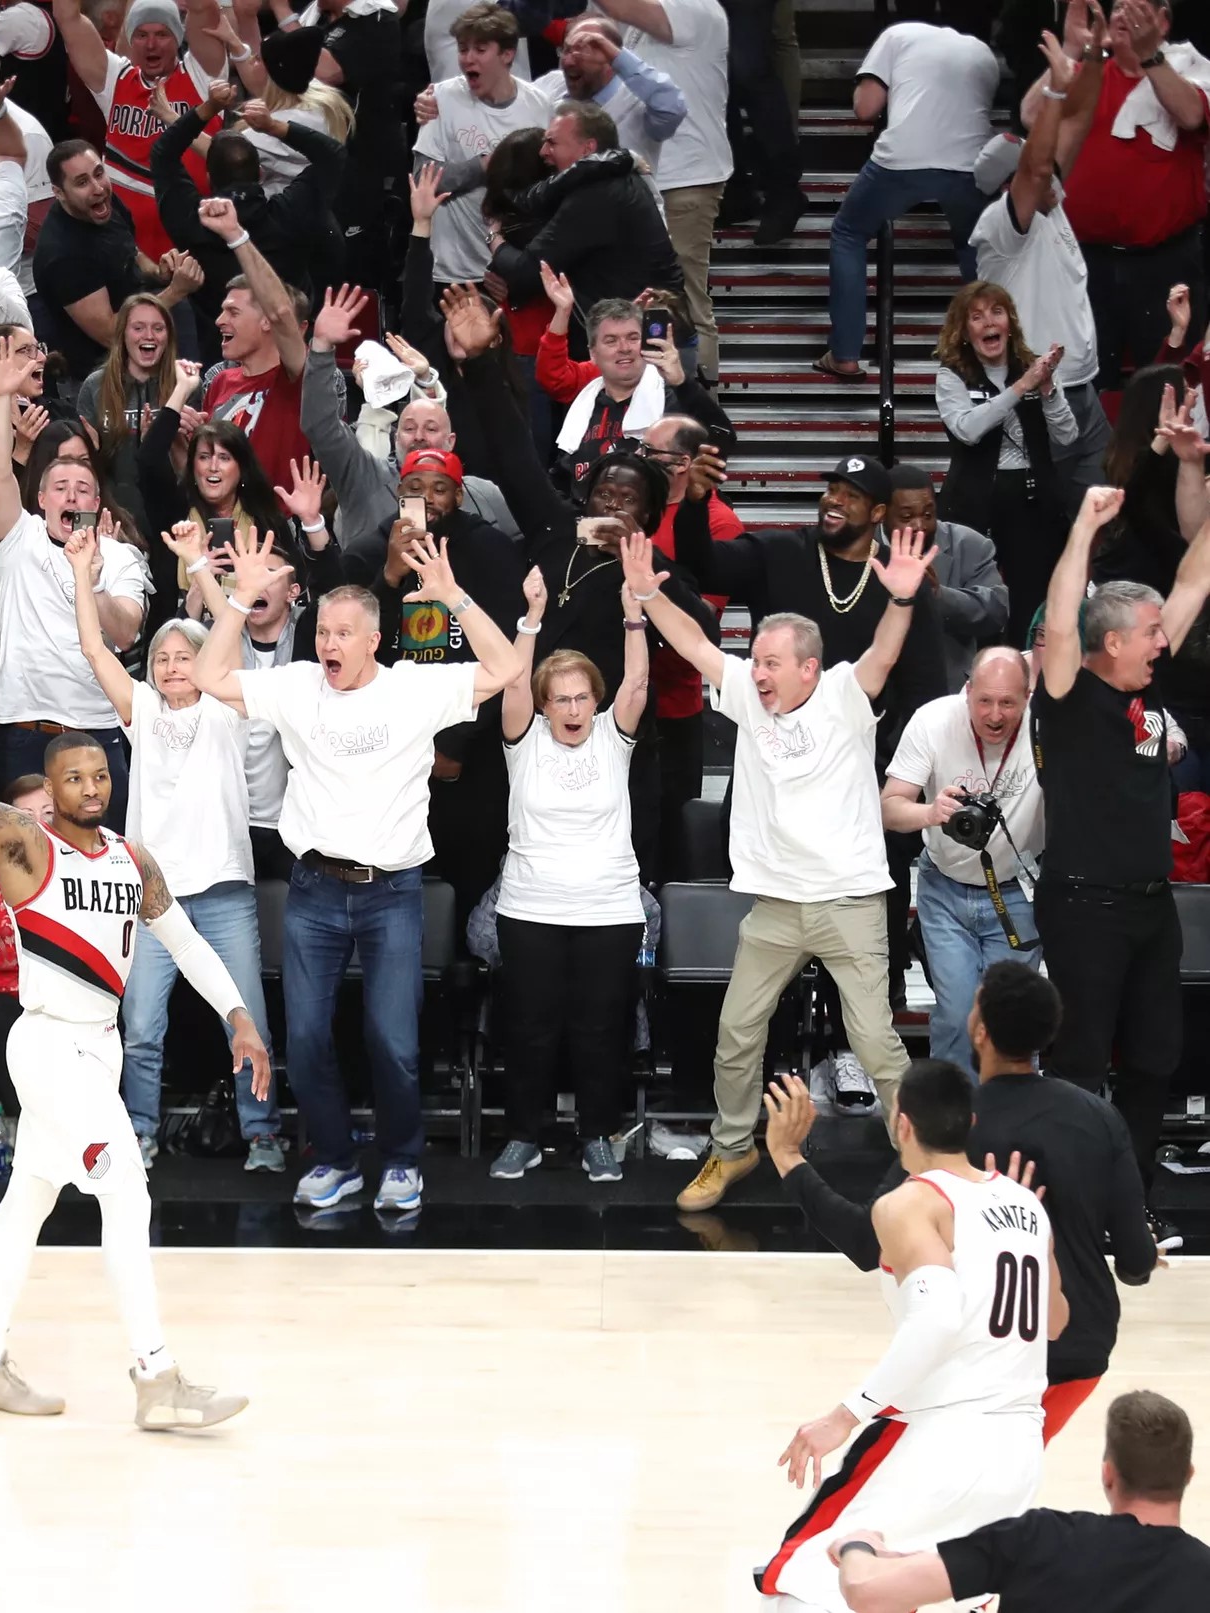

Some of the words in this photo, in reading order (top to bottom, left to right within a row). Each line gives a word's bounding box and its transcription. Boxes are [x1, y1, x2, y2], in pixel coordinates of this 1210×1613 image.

[61, 878, 143, 916] BLAZERS
[122, 919, 134, 959] 0
[980, 1204, 1039, 1236] KANTER
[989, 1250, 1040, 1343] 00
